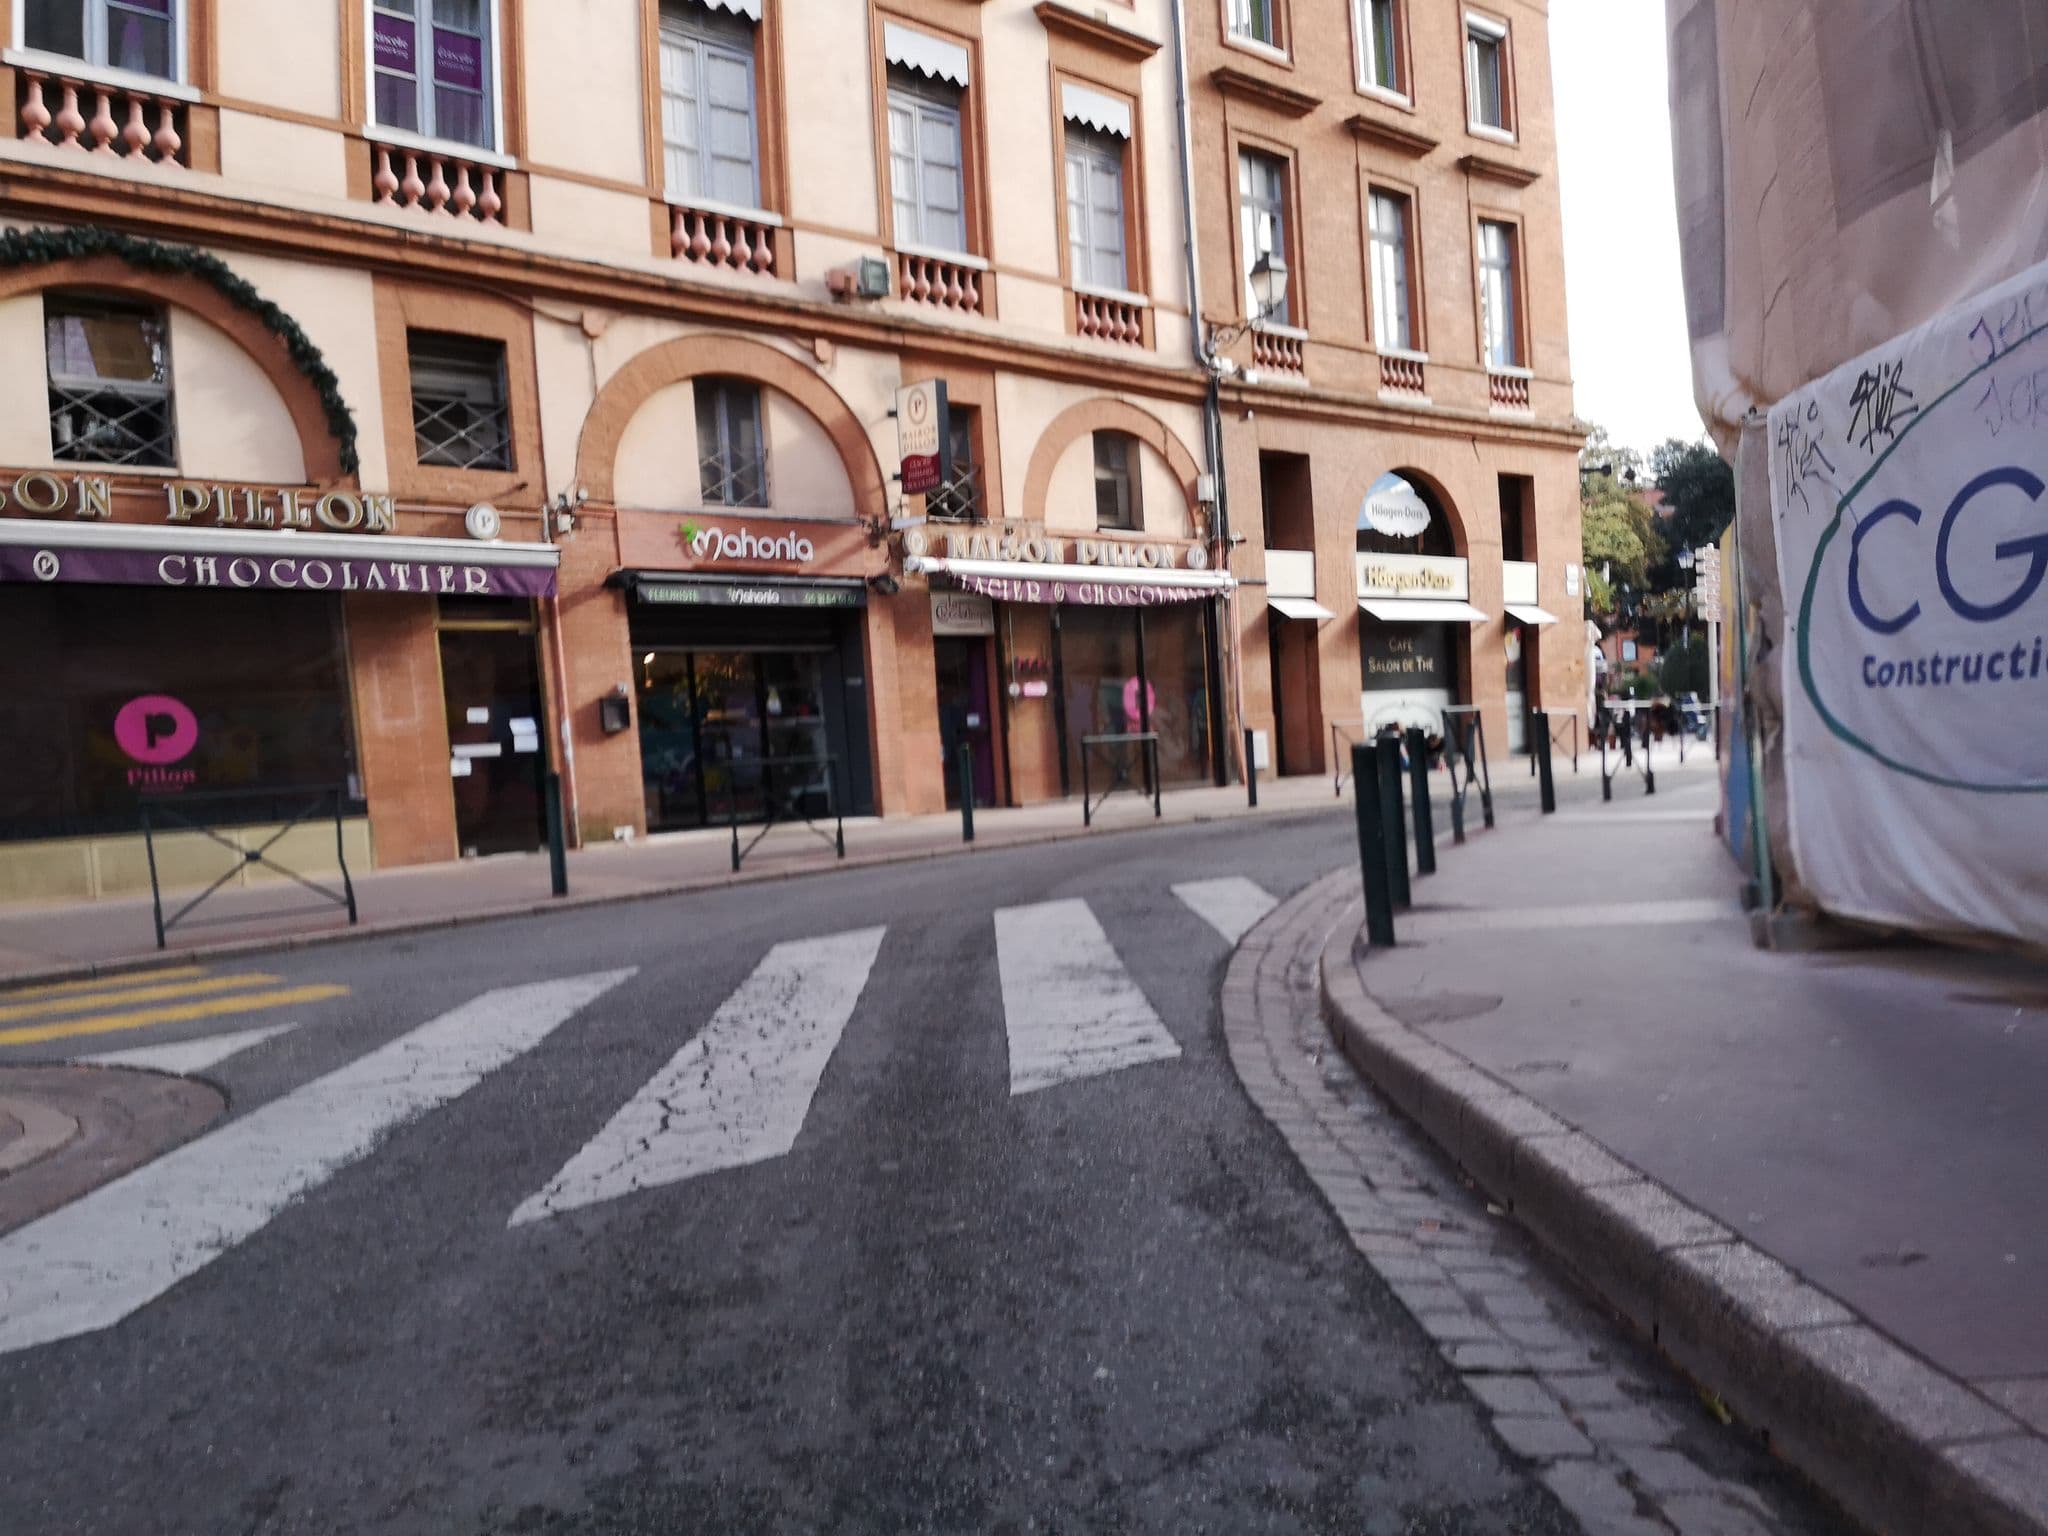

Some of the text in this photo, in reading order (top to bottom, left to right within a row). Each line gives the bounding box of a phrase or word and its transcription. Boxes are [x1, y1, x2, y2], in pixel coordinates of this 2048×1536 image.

[163, 482, 396, 531] PILLON
[692, 526, 814, 562] Mahonia
[947, 532, 1176, 568] MAISON PILLON
[158, 554, 490, 594] CHOCOLATIER
[729, 588, 780, 605] Mahonia
[1863, 636, 2048, 688] Constructi
